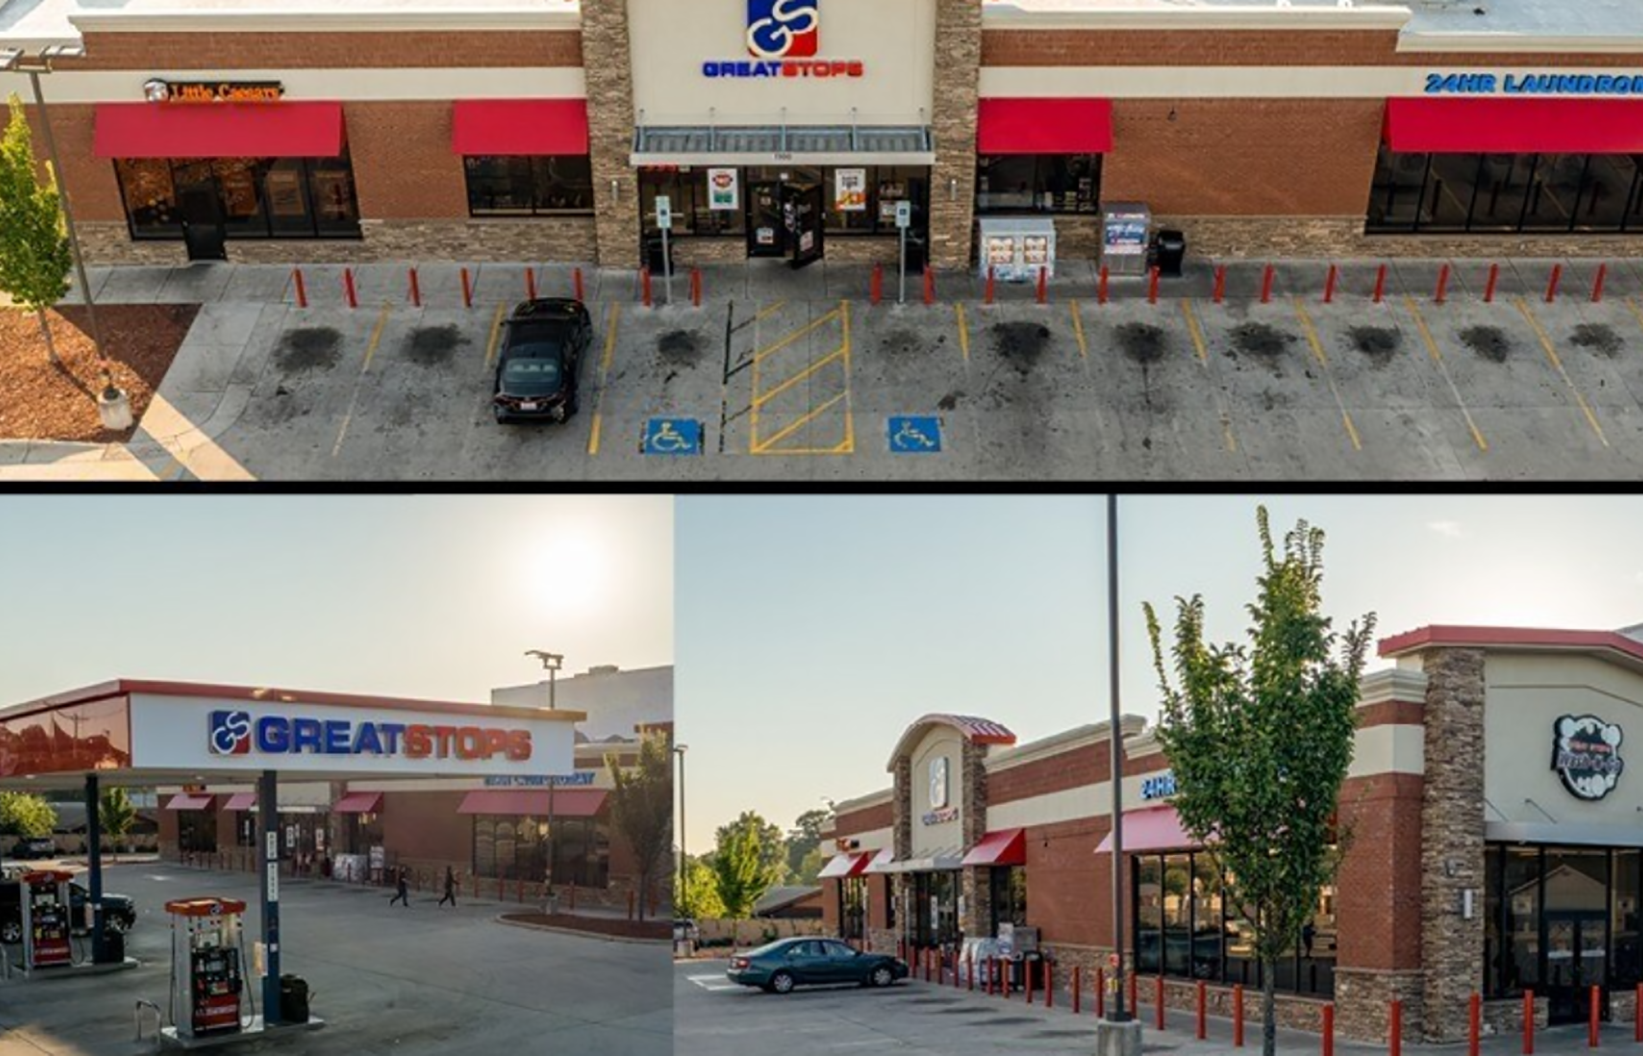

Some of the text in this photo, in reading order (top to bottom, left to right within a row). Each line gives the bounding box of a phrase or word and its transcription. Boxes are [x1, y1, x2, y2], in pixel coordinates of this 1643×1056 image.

[748, 0, 818, 57] GS
[702, 61, 864, 78] GREATSTOPS
[172, 83, 214, 101] Little
[1424, 73, 1496, 93] 24HR
[255, 716, 532, 761] GREATSTOPS
